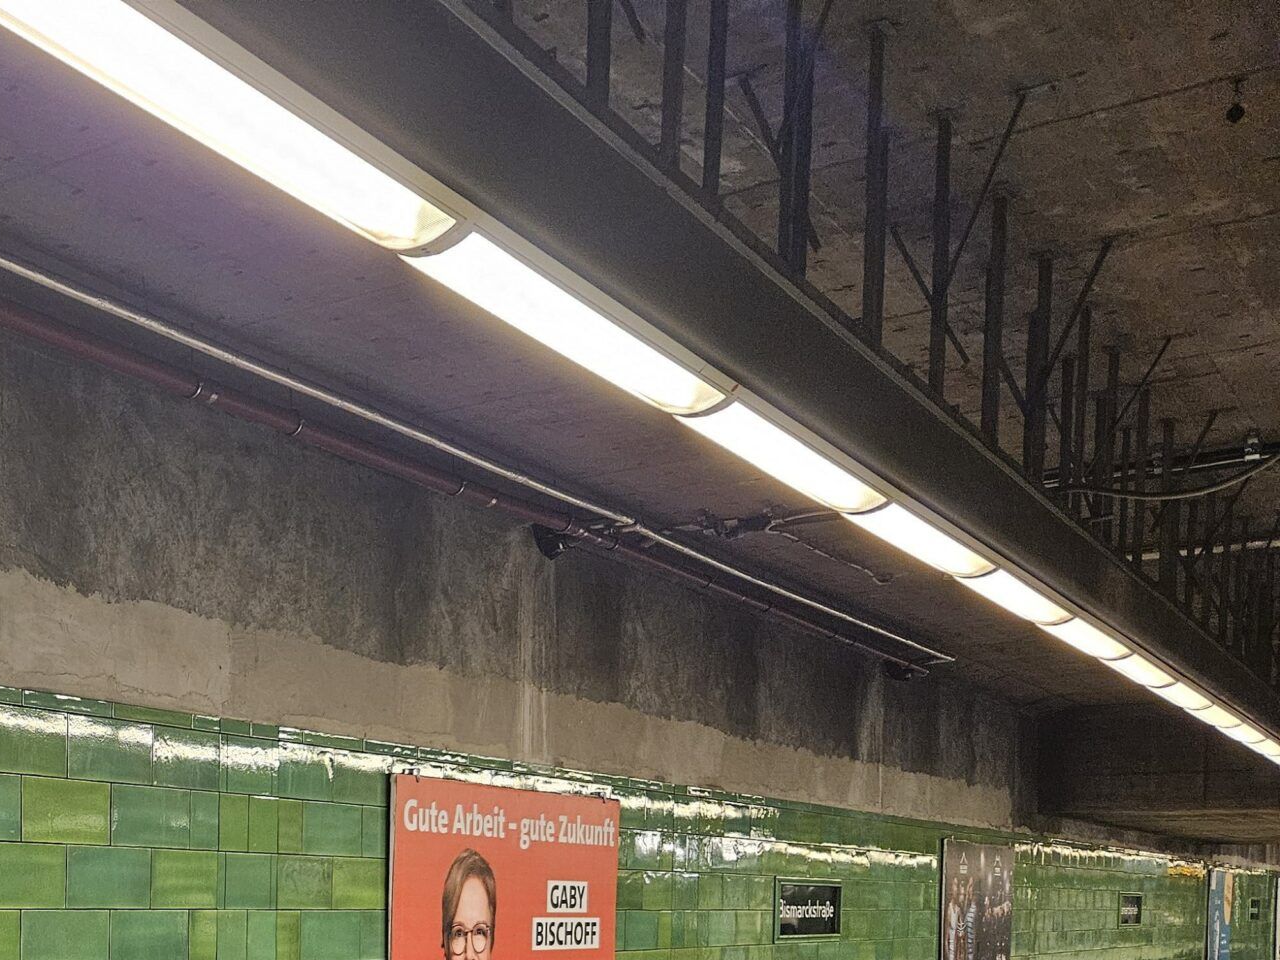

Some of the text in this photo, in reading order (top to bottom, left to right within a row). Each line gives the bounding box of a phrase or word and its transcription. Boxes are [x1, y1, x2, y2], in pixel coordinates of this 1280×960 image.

[403, 799, 449, 834] Gute
[452, 804, 505, 839] Arbeit
[520, 813, 555, 850] gute
[558, 815, 615, 847] Zukunft
[550, 884, 585, 909] GABY
[535, 921, 597, 946] BISCHOFF
